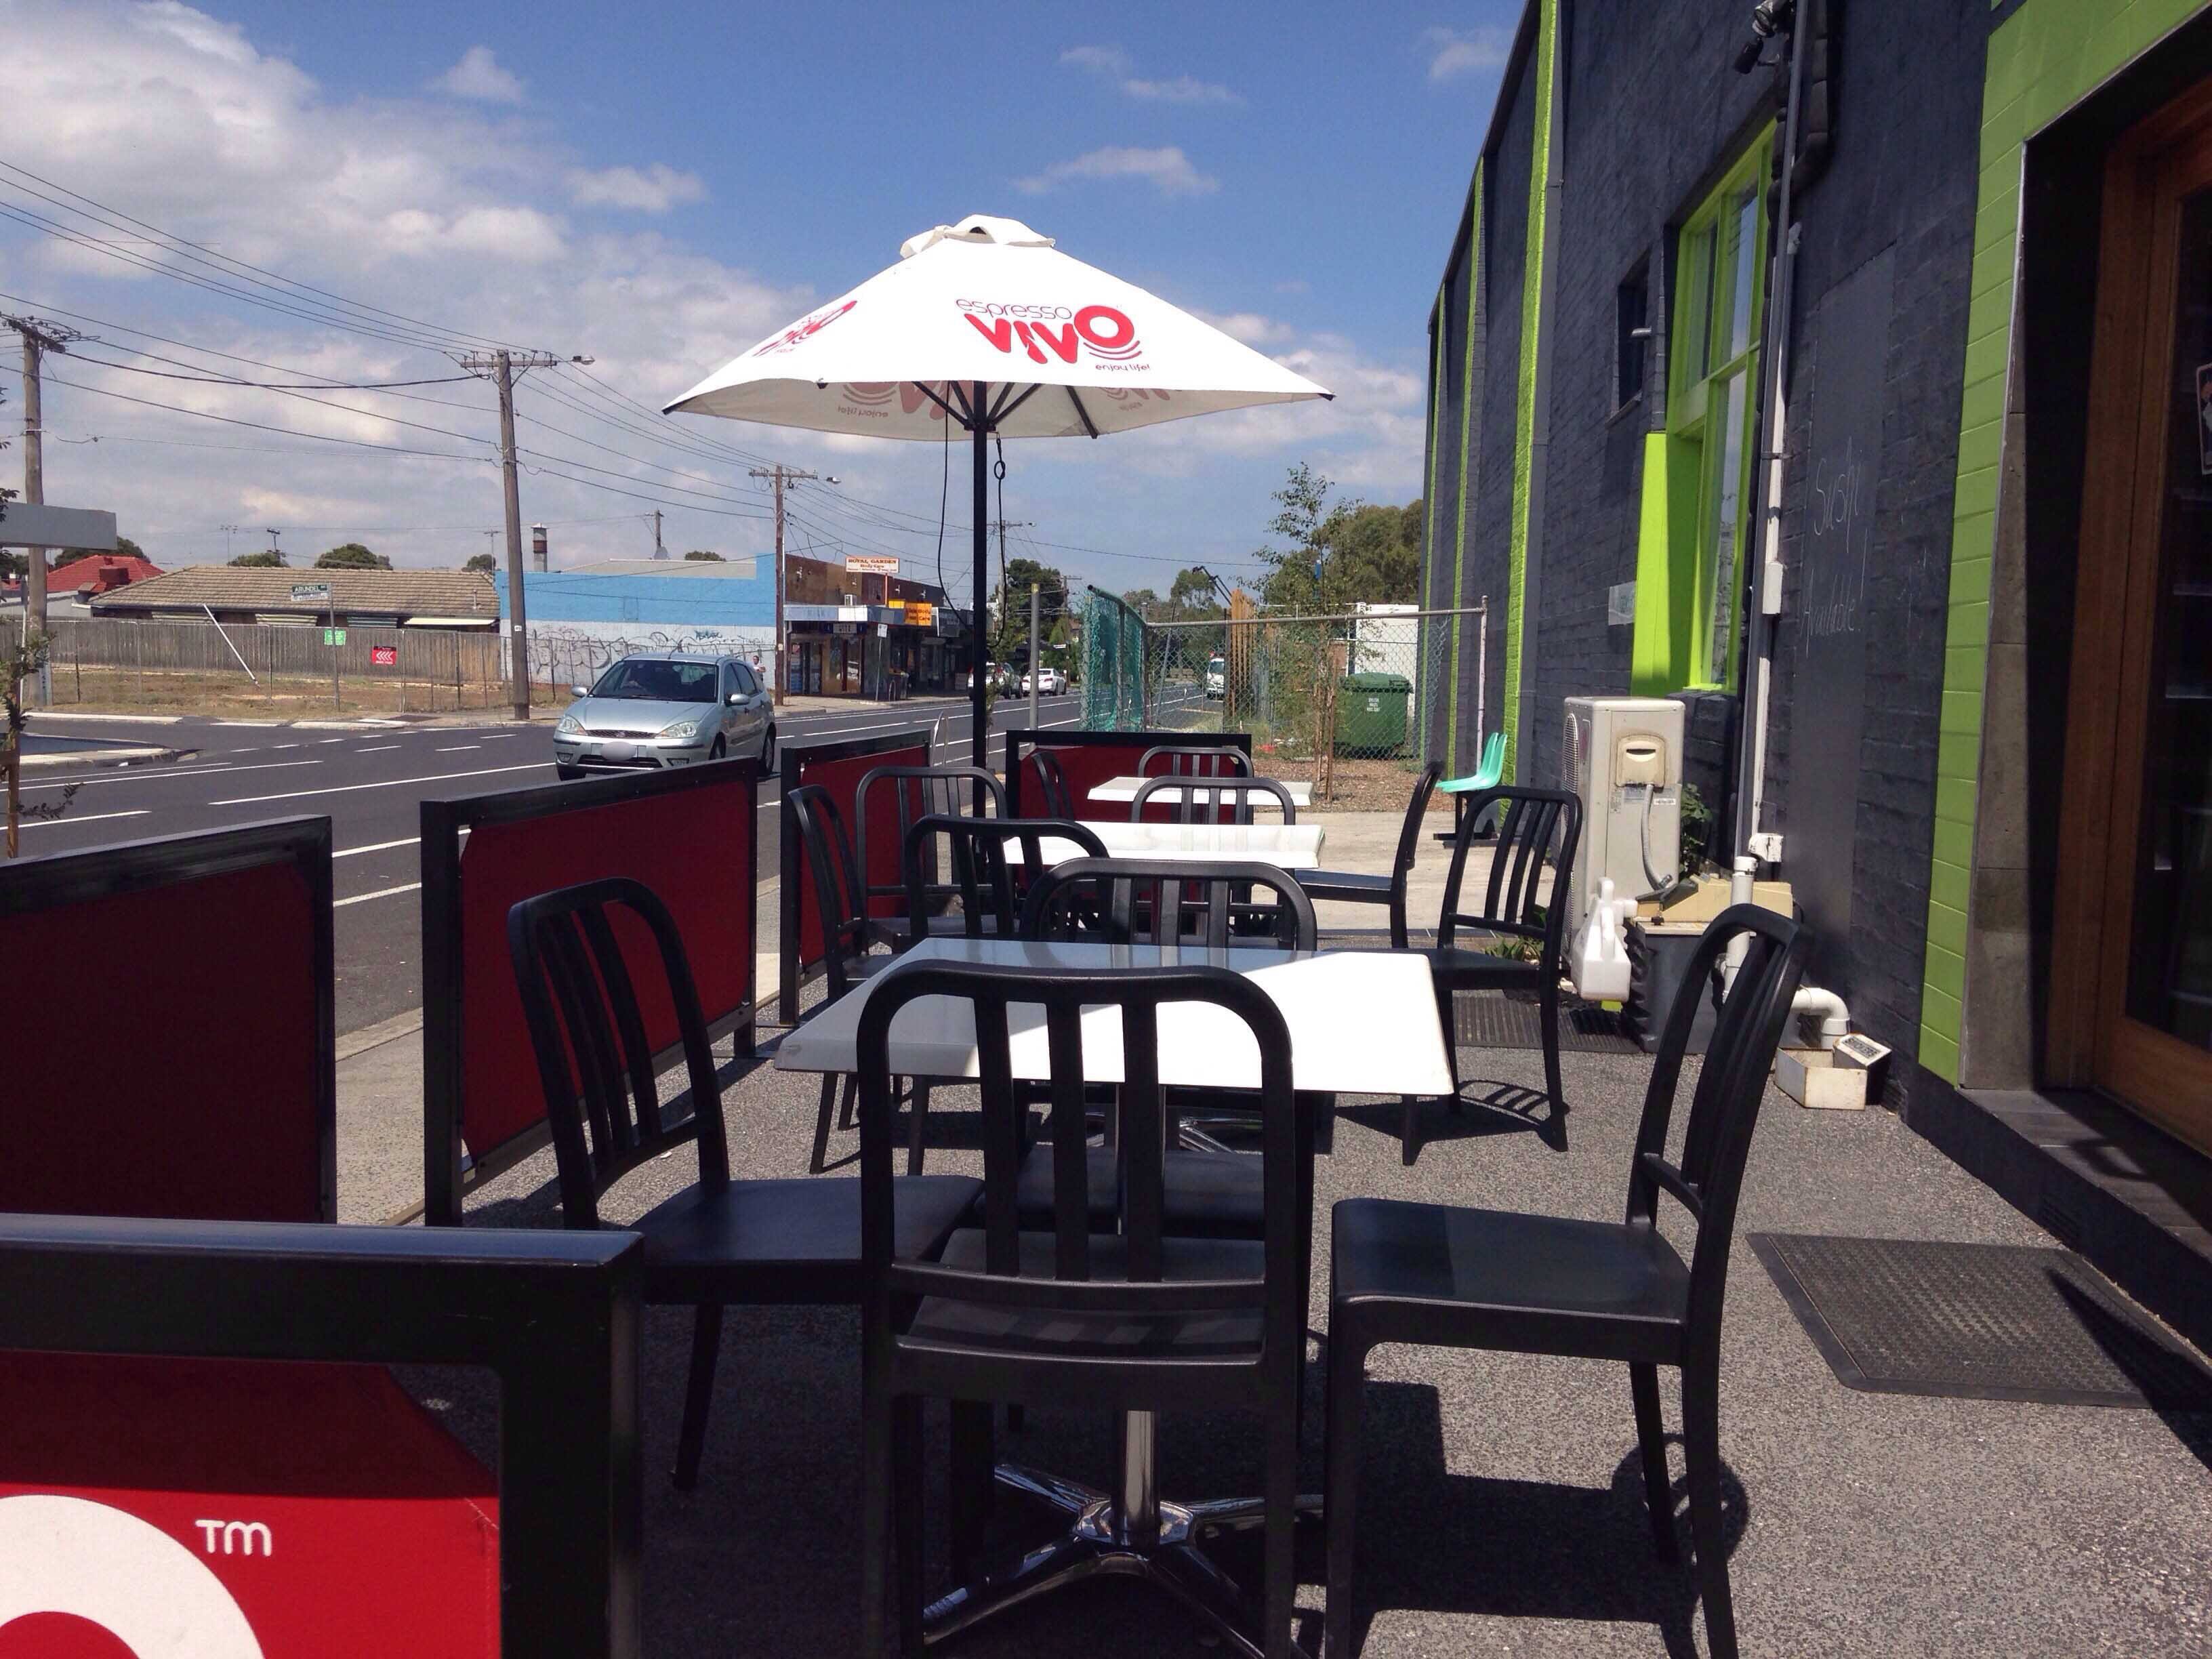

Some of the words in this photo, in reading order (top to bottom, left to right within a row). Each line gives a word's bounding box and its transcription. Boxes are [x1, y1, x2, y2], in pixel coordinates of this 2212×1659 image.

[956, 298, 1072, 319] espresso
[1095, 363, 1128, 372] enjoy
[1129, 363, 1150, 371] life!
